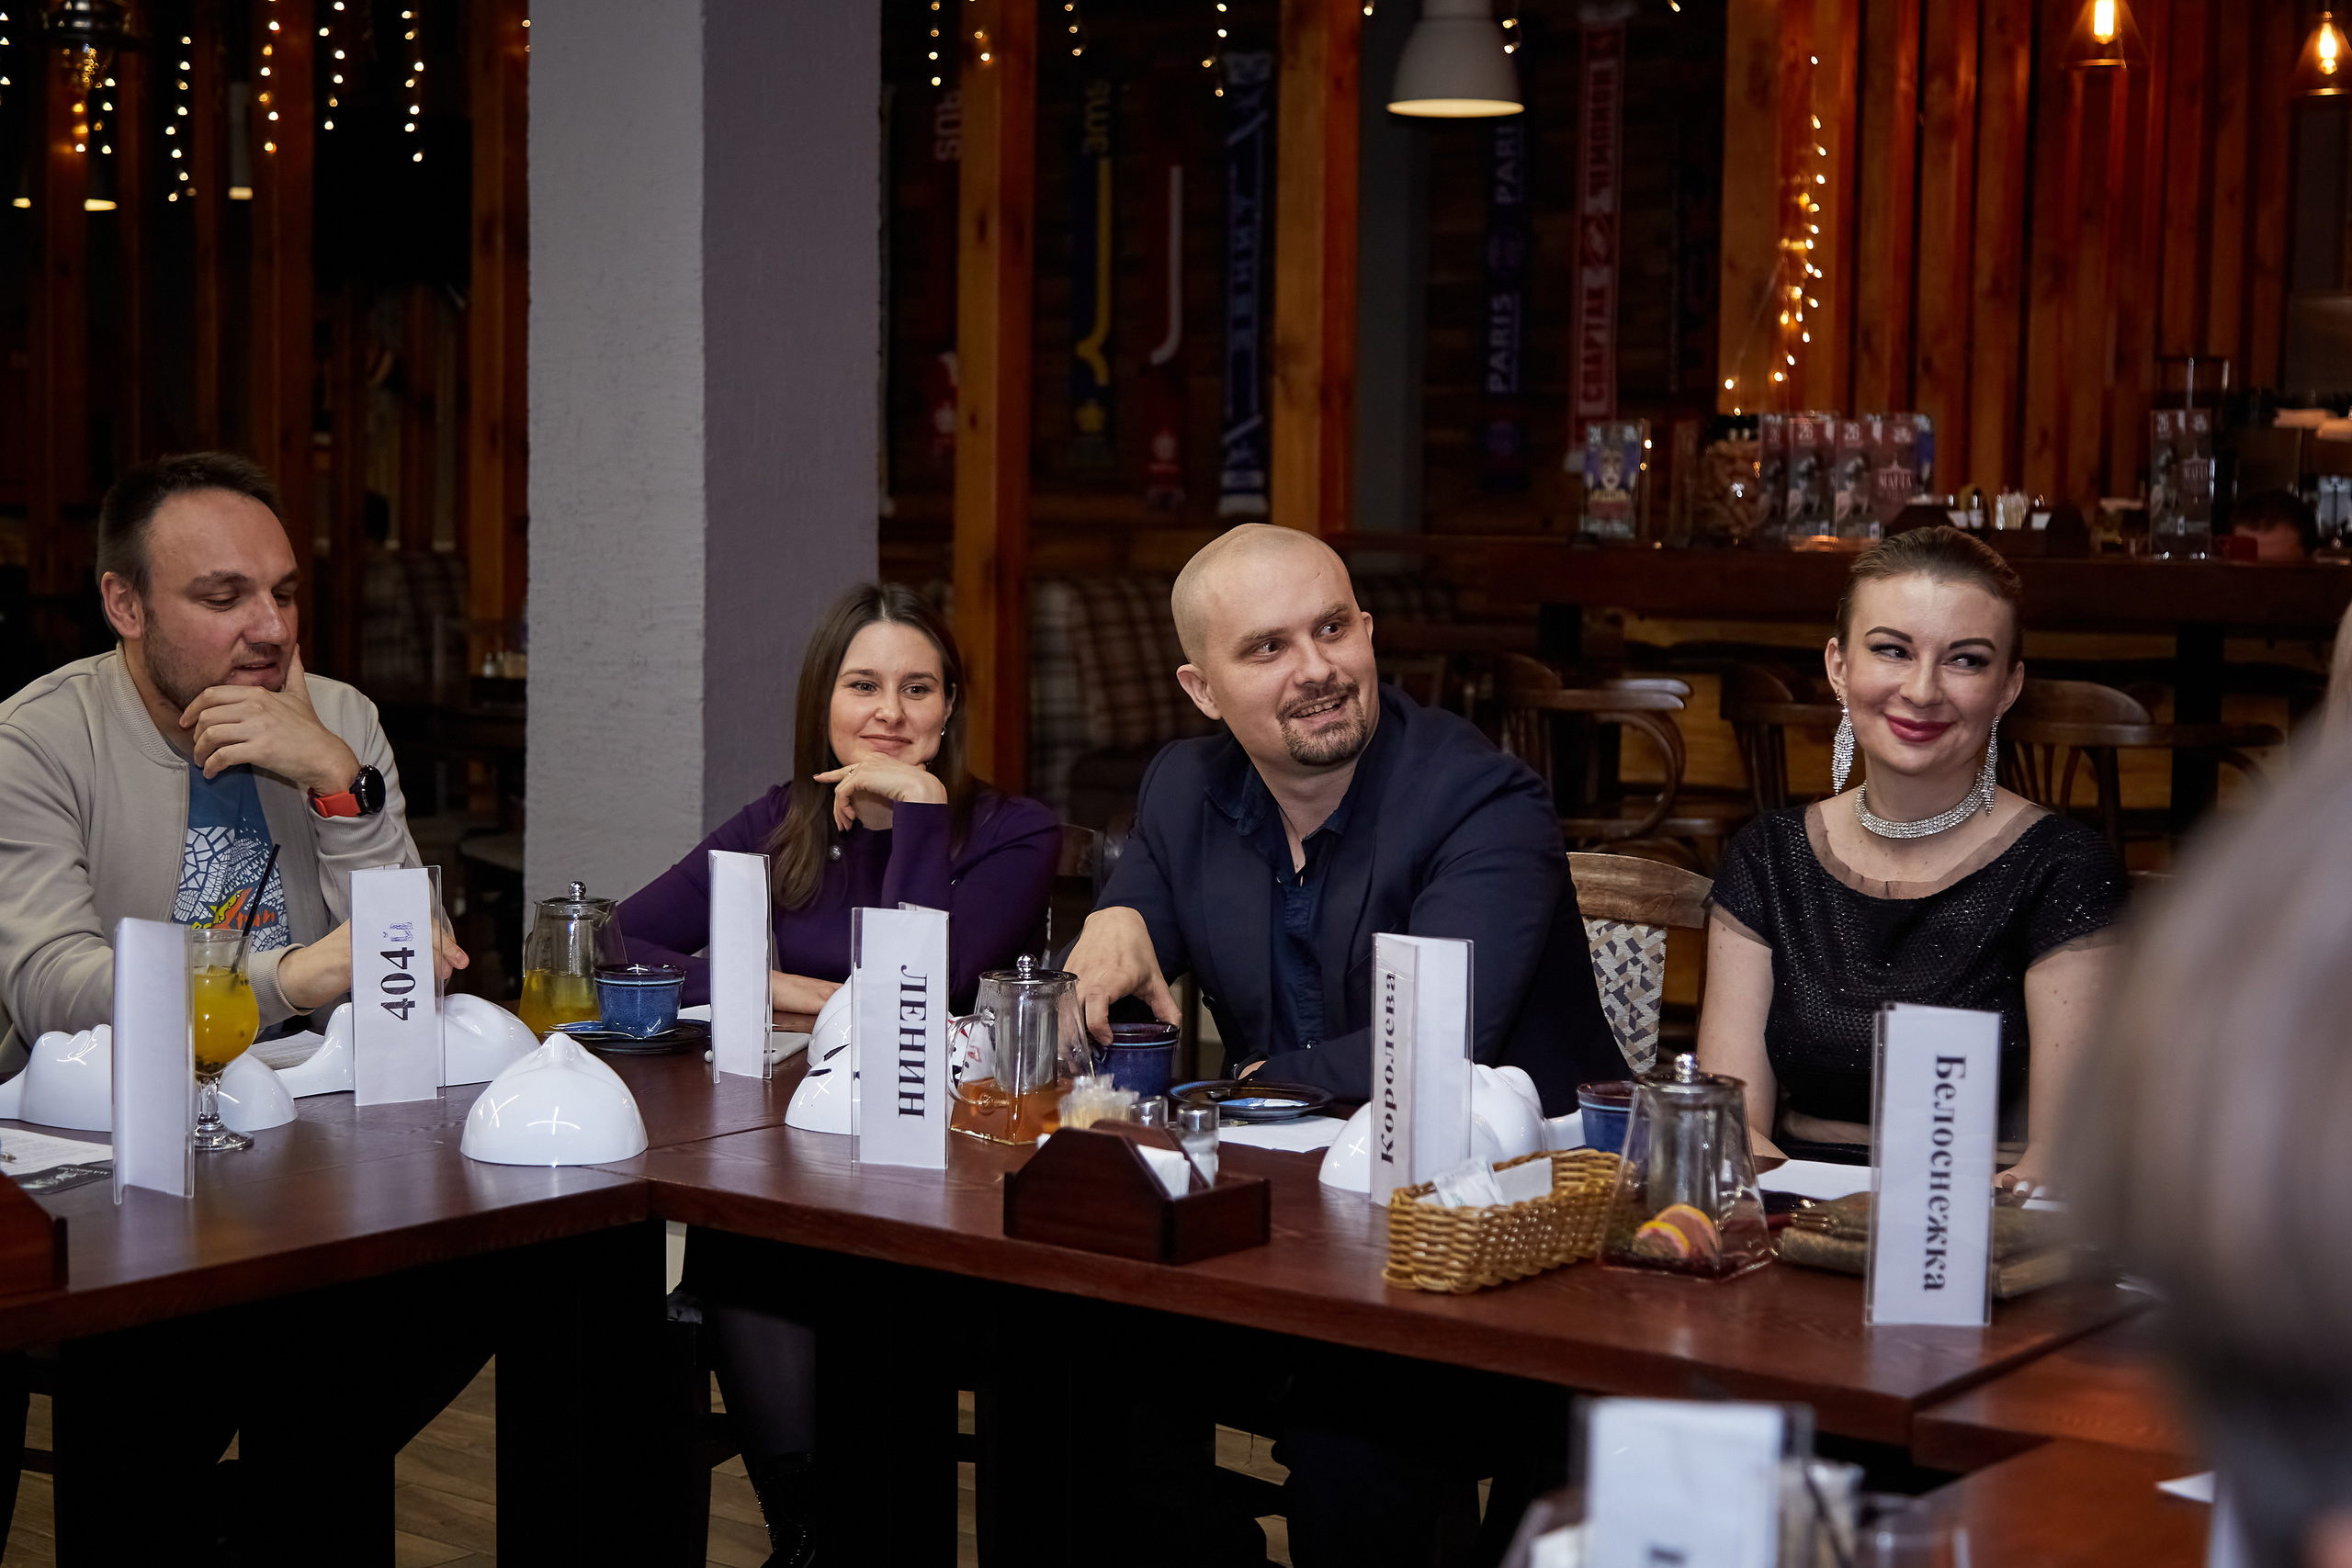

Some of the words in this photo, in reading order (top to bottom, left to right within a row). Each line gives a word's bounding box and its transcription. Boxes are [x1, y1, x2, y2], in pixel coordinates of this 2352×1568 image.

[1494, 121, 1517, 205] PARI
[1486, 293, 1512, 394] PARIS
[899, 964, 928, 1121] ЛЕНИН
[1380, 972, 1396, 1165] Королева
[1923, 1054, 1967, 1292] Белоснежка
